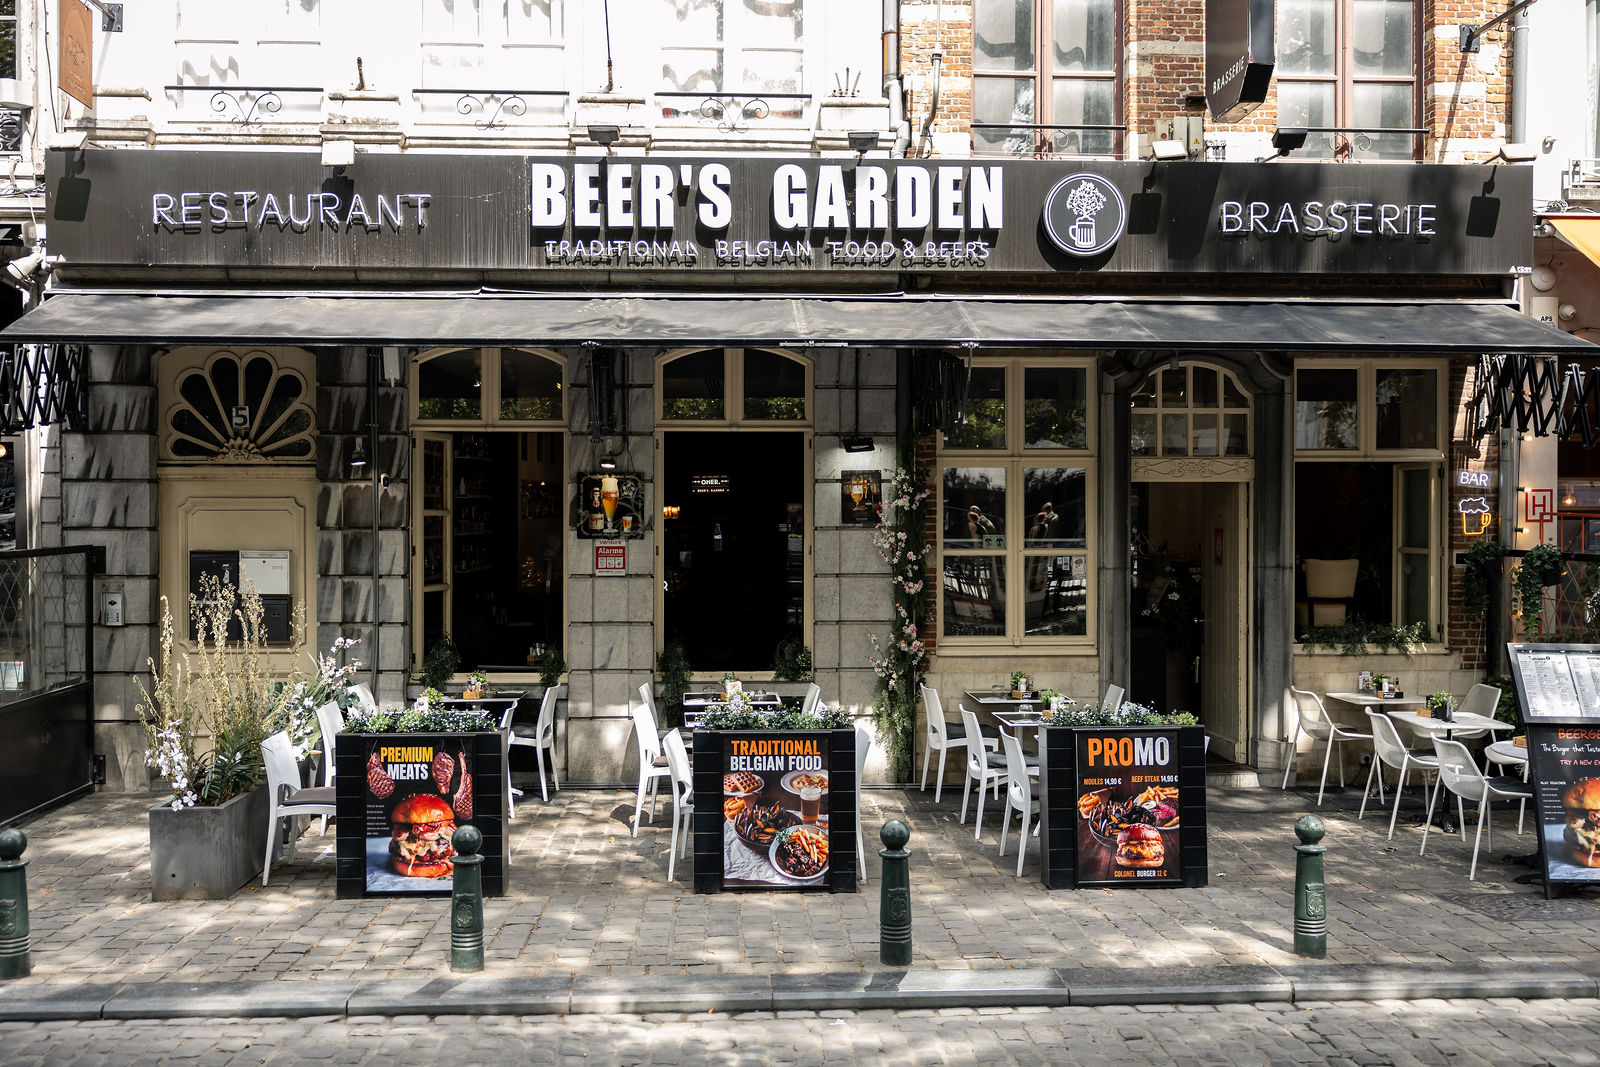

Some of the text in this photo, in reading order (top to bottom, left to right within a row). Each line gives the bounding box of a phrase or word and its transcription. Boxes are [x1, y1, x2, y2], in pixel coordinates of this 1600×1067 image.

[1213, 56, 1245, 94] BRASSERIE
[531, 163, 1004, 229] BEER'S GARDEN
[153, 191, 431, 226] RESTAURANT
[1222, 201, 1437, 235] BRASSERIE
[545, 240, 990, 259] TRADITIONAL BELGIAN FOOD & BEERS
[234, 406, 249, 426] 5
[1460, 471, 1489, 487] BAR
[1532, 495, 1546, 516] H
[380, 746, 434, 763] PREMIUM
[731, 740, 821, 755] TRADITIONAL
[1088, 736, 1170, 767] PROMO
[1541, 743, 1551, 752] The
[1572, 743, 1585, 753] that
[387, 763, 429, 780] MEATS
[730, 755, 822, 771] BELGIAN FOOD
[1083, 778, 1104, 786] MOULES
[1131, 775, 1144, 783] BEEF
[1144, 775, 1160, 783] STEAK
[1114, 870, 1136, 878] COLONEL
